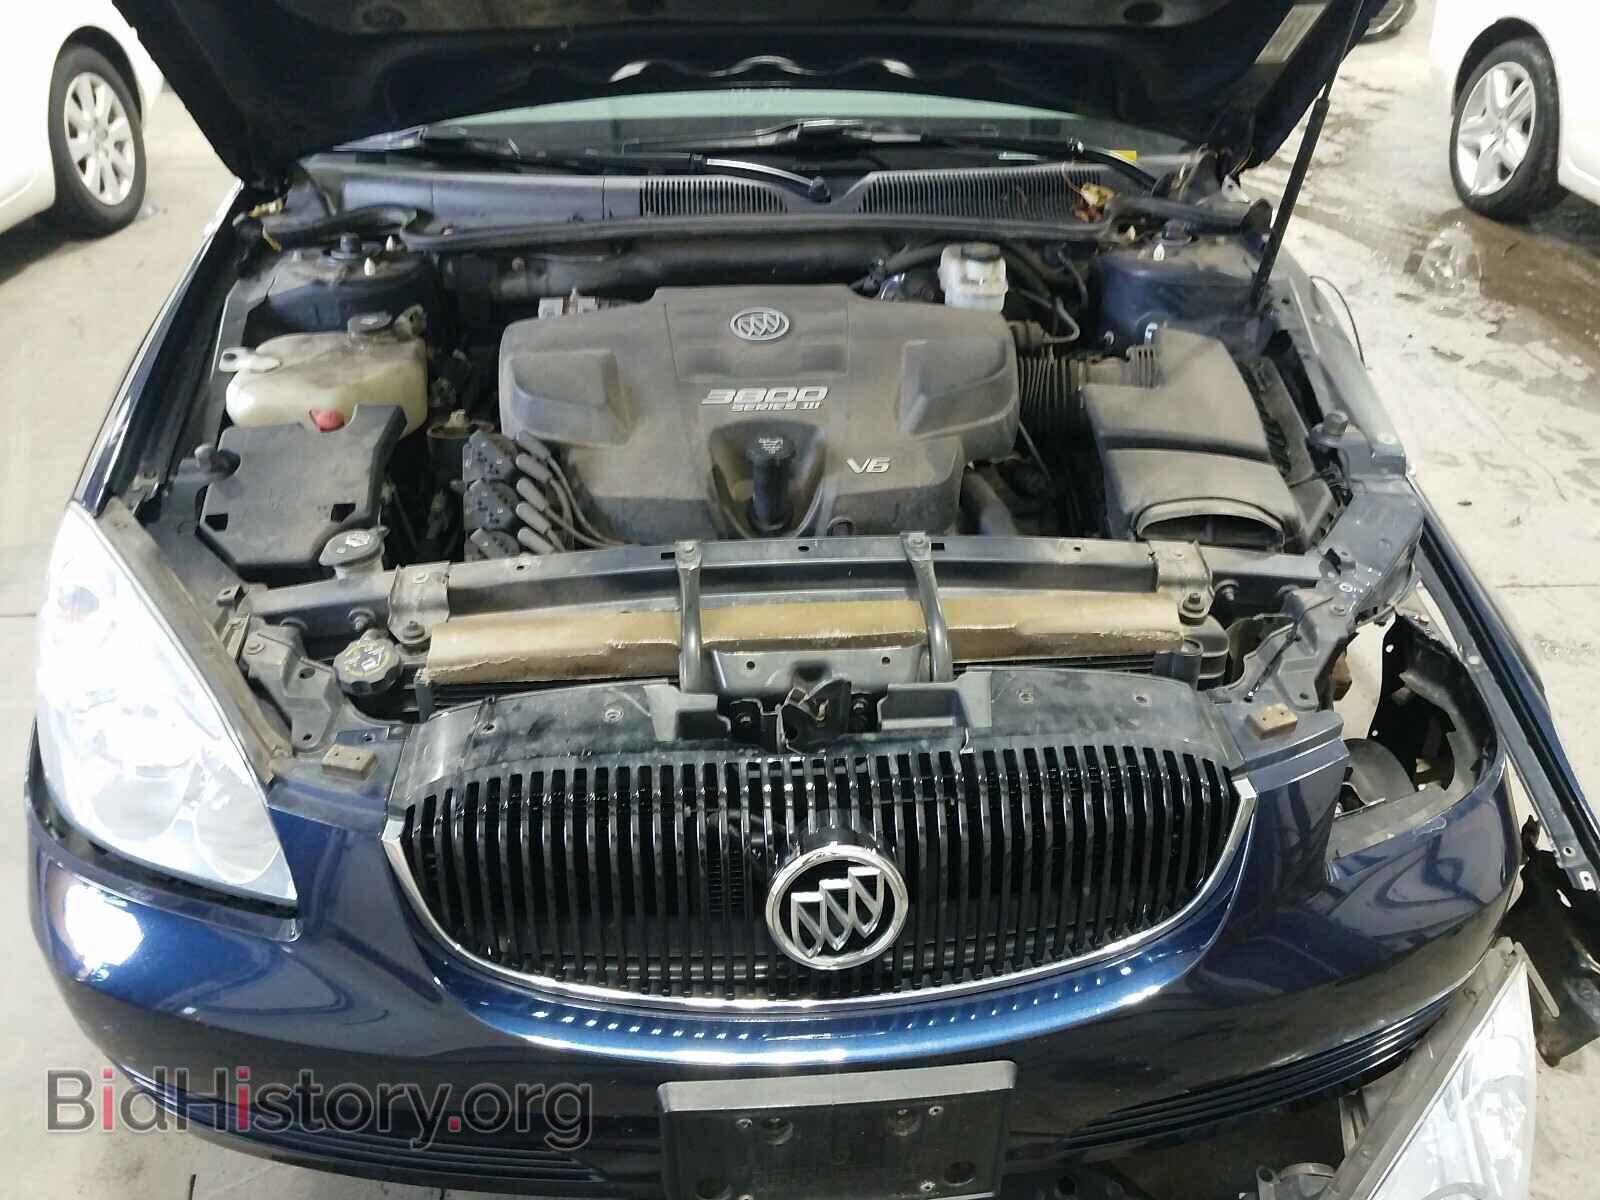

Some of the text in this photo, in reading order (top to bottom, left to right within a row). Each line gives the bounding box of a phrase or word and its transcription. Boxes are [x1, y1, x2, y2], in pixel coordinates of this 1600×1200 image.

[701, 386, 829, 405] 3800
[731, 401, 822, 412] SERIES III
[847, 456, 892, 474] V6
